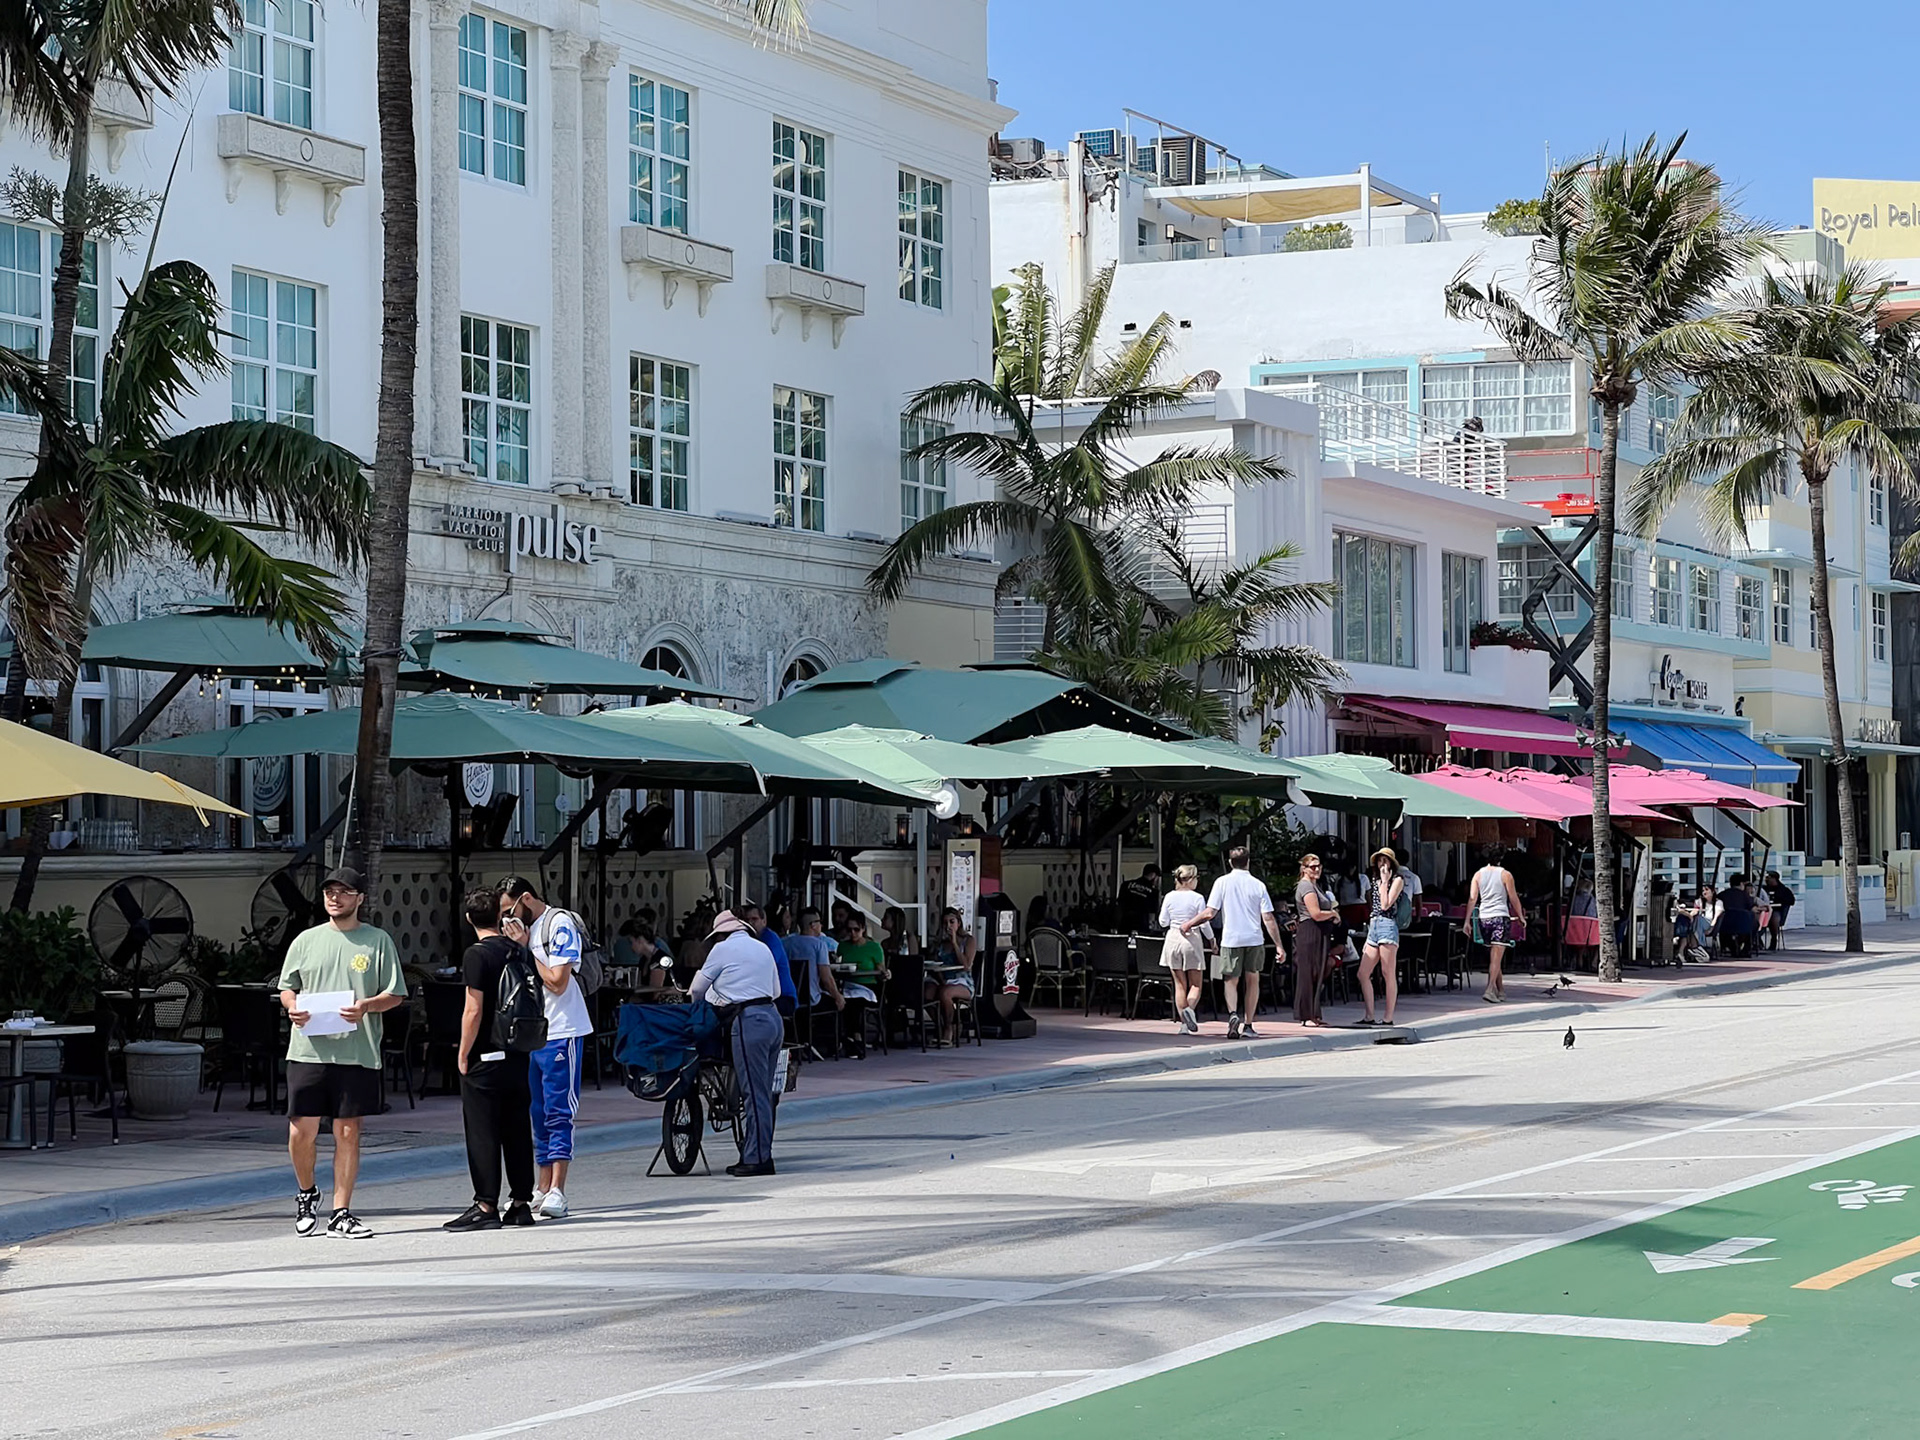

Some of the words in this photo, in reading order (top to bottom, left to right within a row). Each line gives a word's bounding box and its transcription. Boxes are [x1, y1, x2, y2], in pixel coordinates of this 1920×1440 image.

[1822, 203, 1878, 245] Royal
[1888, 202, 1920, 228] Pal
[449, 505, 506, 523] MARRIOTT
[449, 521, 505, 538] VACATION
[477, 538, 505, 554] CLUB
[509, 504, 602, 574] pulse
